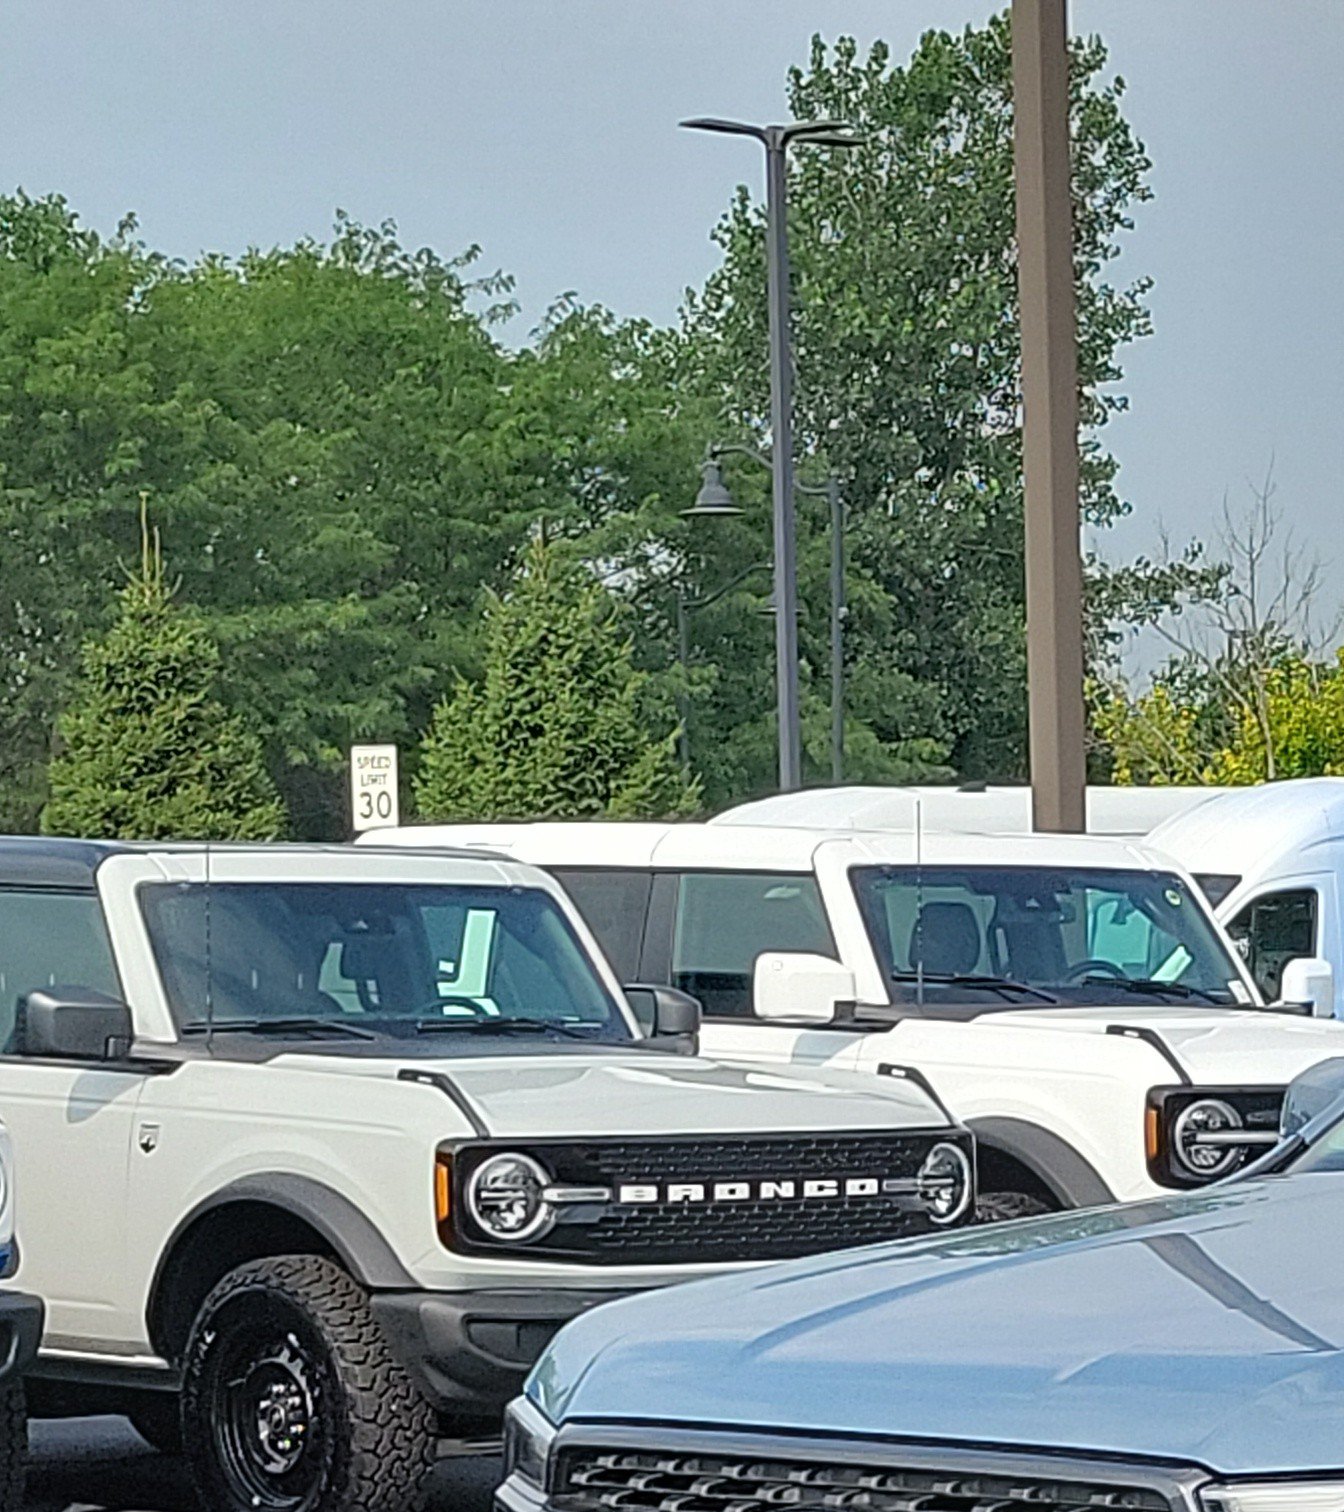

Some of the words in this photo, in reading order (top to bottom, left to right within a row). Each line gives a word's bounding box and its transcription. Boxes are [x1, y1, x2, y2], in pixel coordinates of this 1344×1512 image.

[357, 755, 392, 770] SPEED
[360, 773, 388, 788] LIMIT
[359, 790, 393, 820] 30
[619, 1178, 879, 1204] BRONCO
